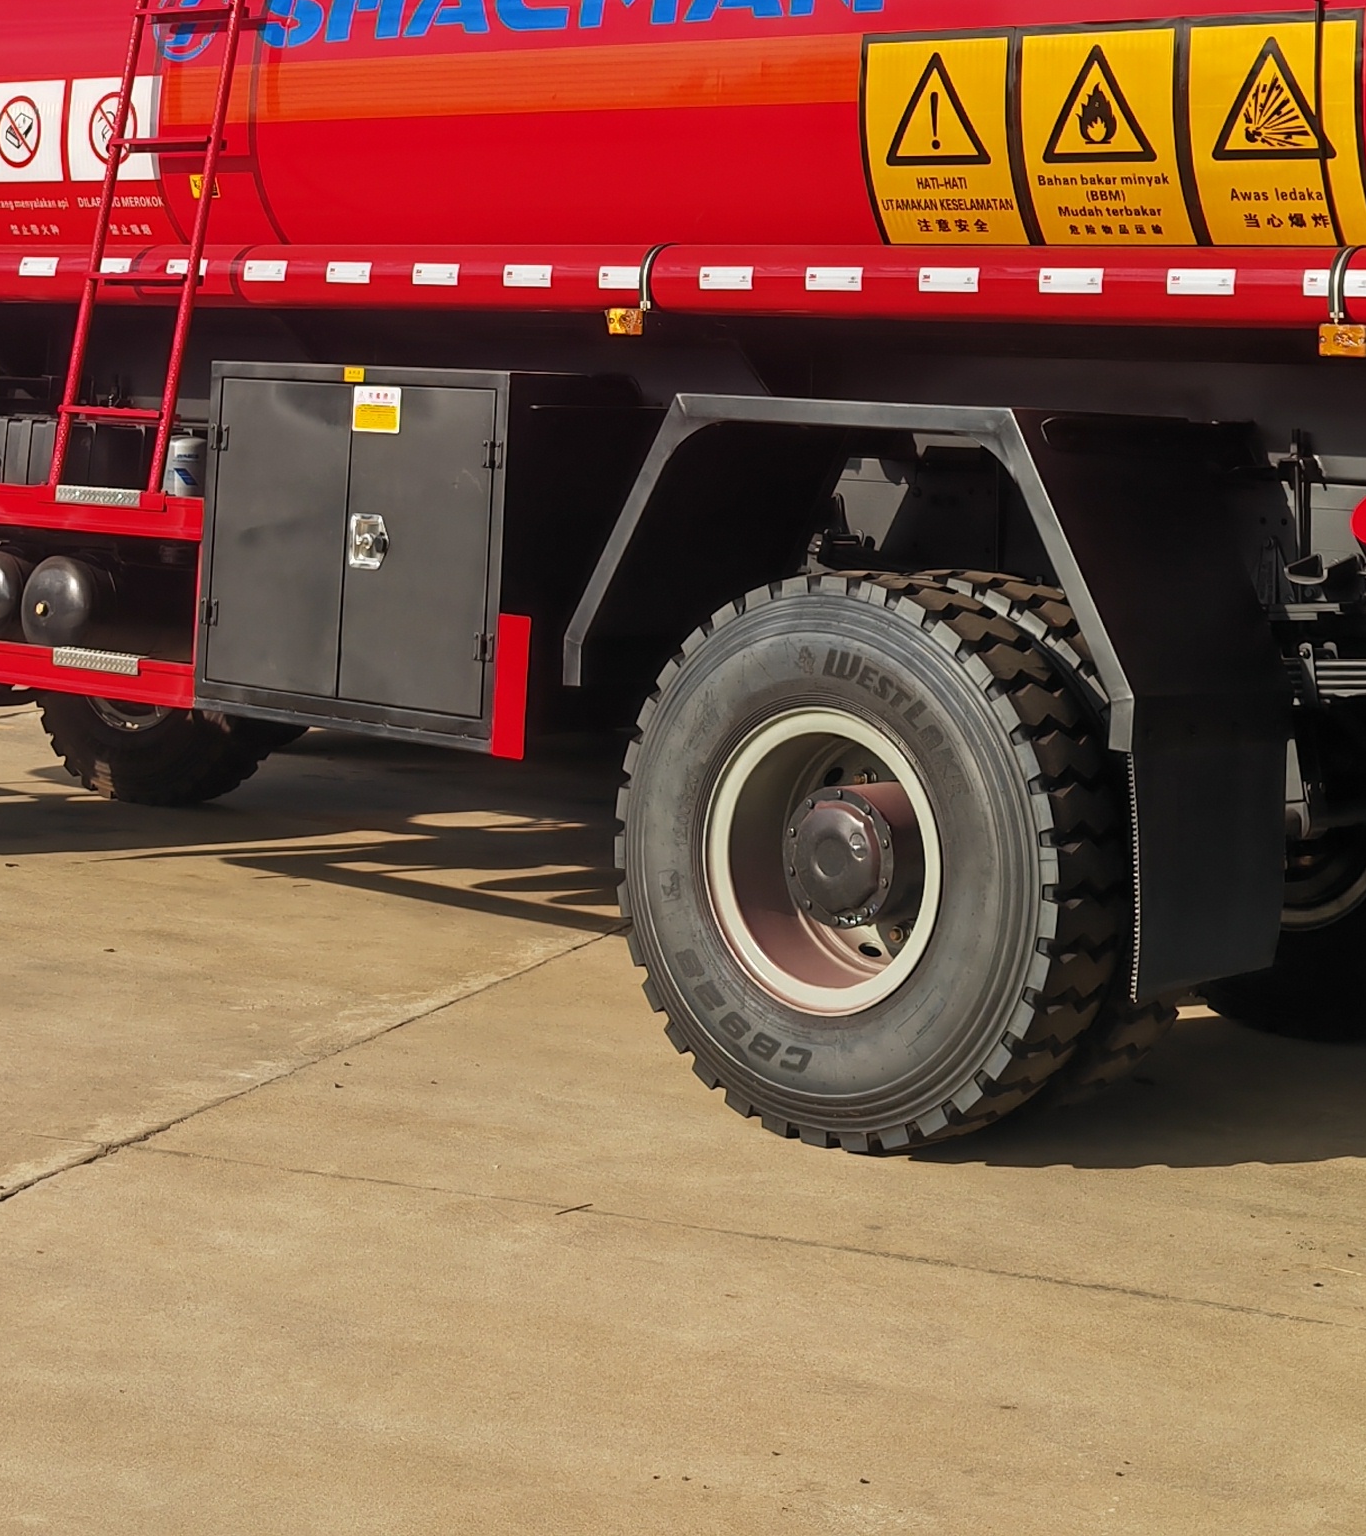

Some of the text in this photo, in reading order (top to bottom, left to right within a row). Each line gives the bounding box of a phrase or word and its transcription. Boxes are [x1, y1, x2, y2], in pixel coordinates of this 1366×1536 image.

[916, 176, 968, 190] HATI-HATI
[1037, 173, 1170, 187] Bahan bakar minyak
[1085, 190, 1126, 202] (BBM)
[1230, 187, 1325, 202] Awas ledaka
[121, 196, 165, 208] MEROKOK
[881, 198, 1014, 211] UTAMAKAN KESELAMATAN
[1057, 205, 1162, 217] Mudah terbakar
[917, 218, 990, 233] 注意安全
[1243, 213, 1331, 228] 当心爆炸
[675, 948, 813, 1073] CB928
